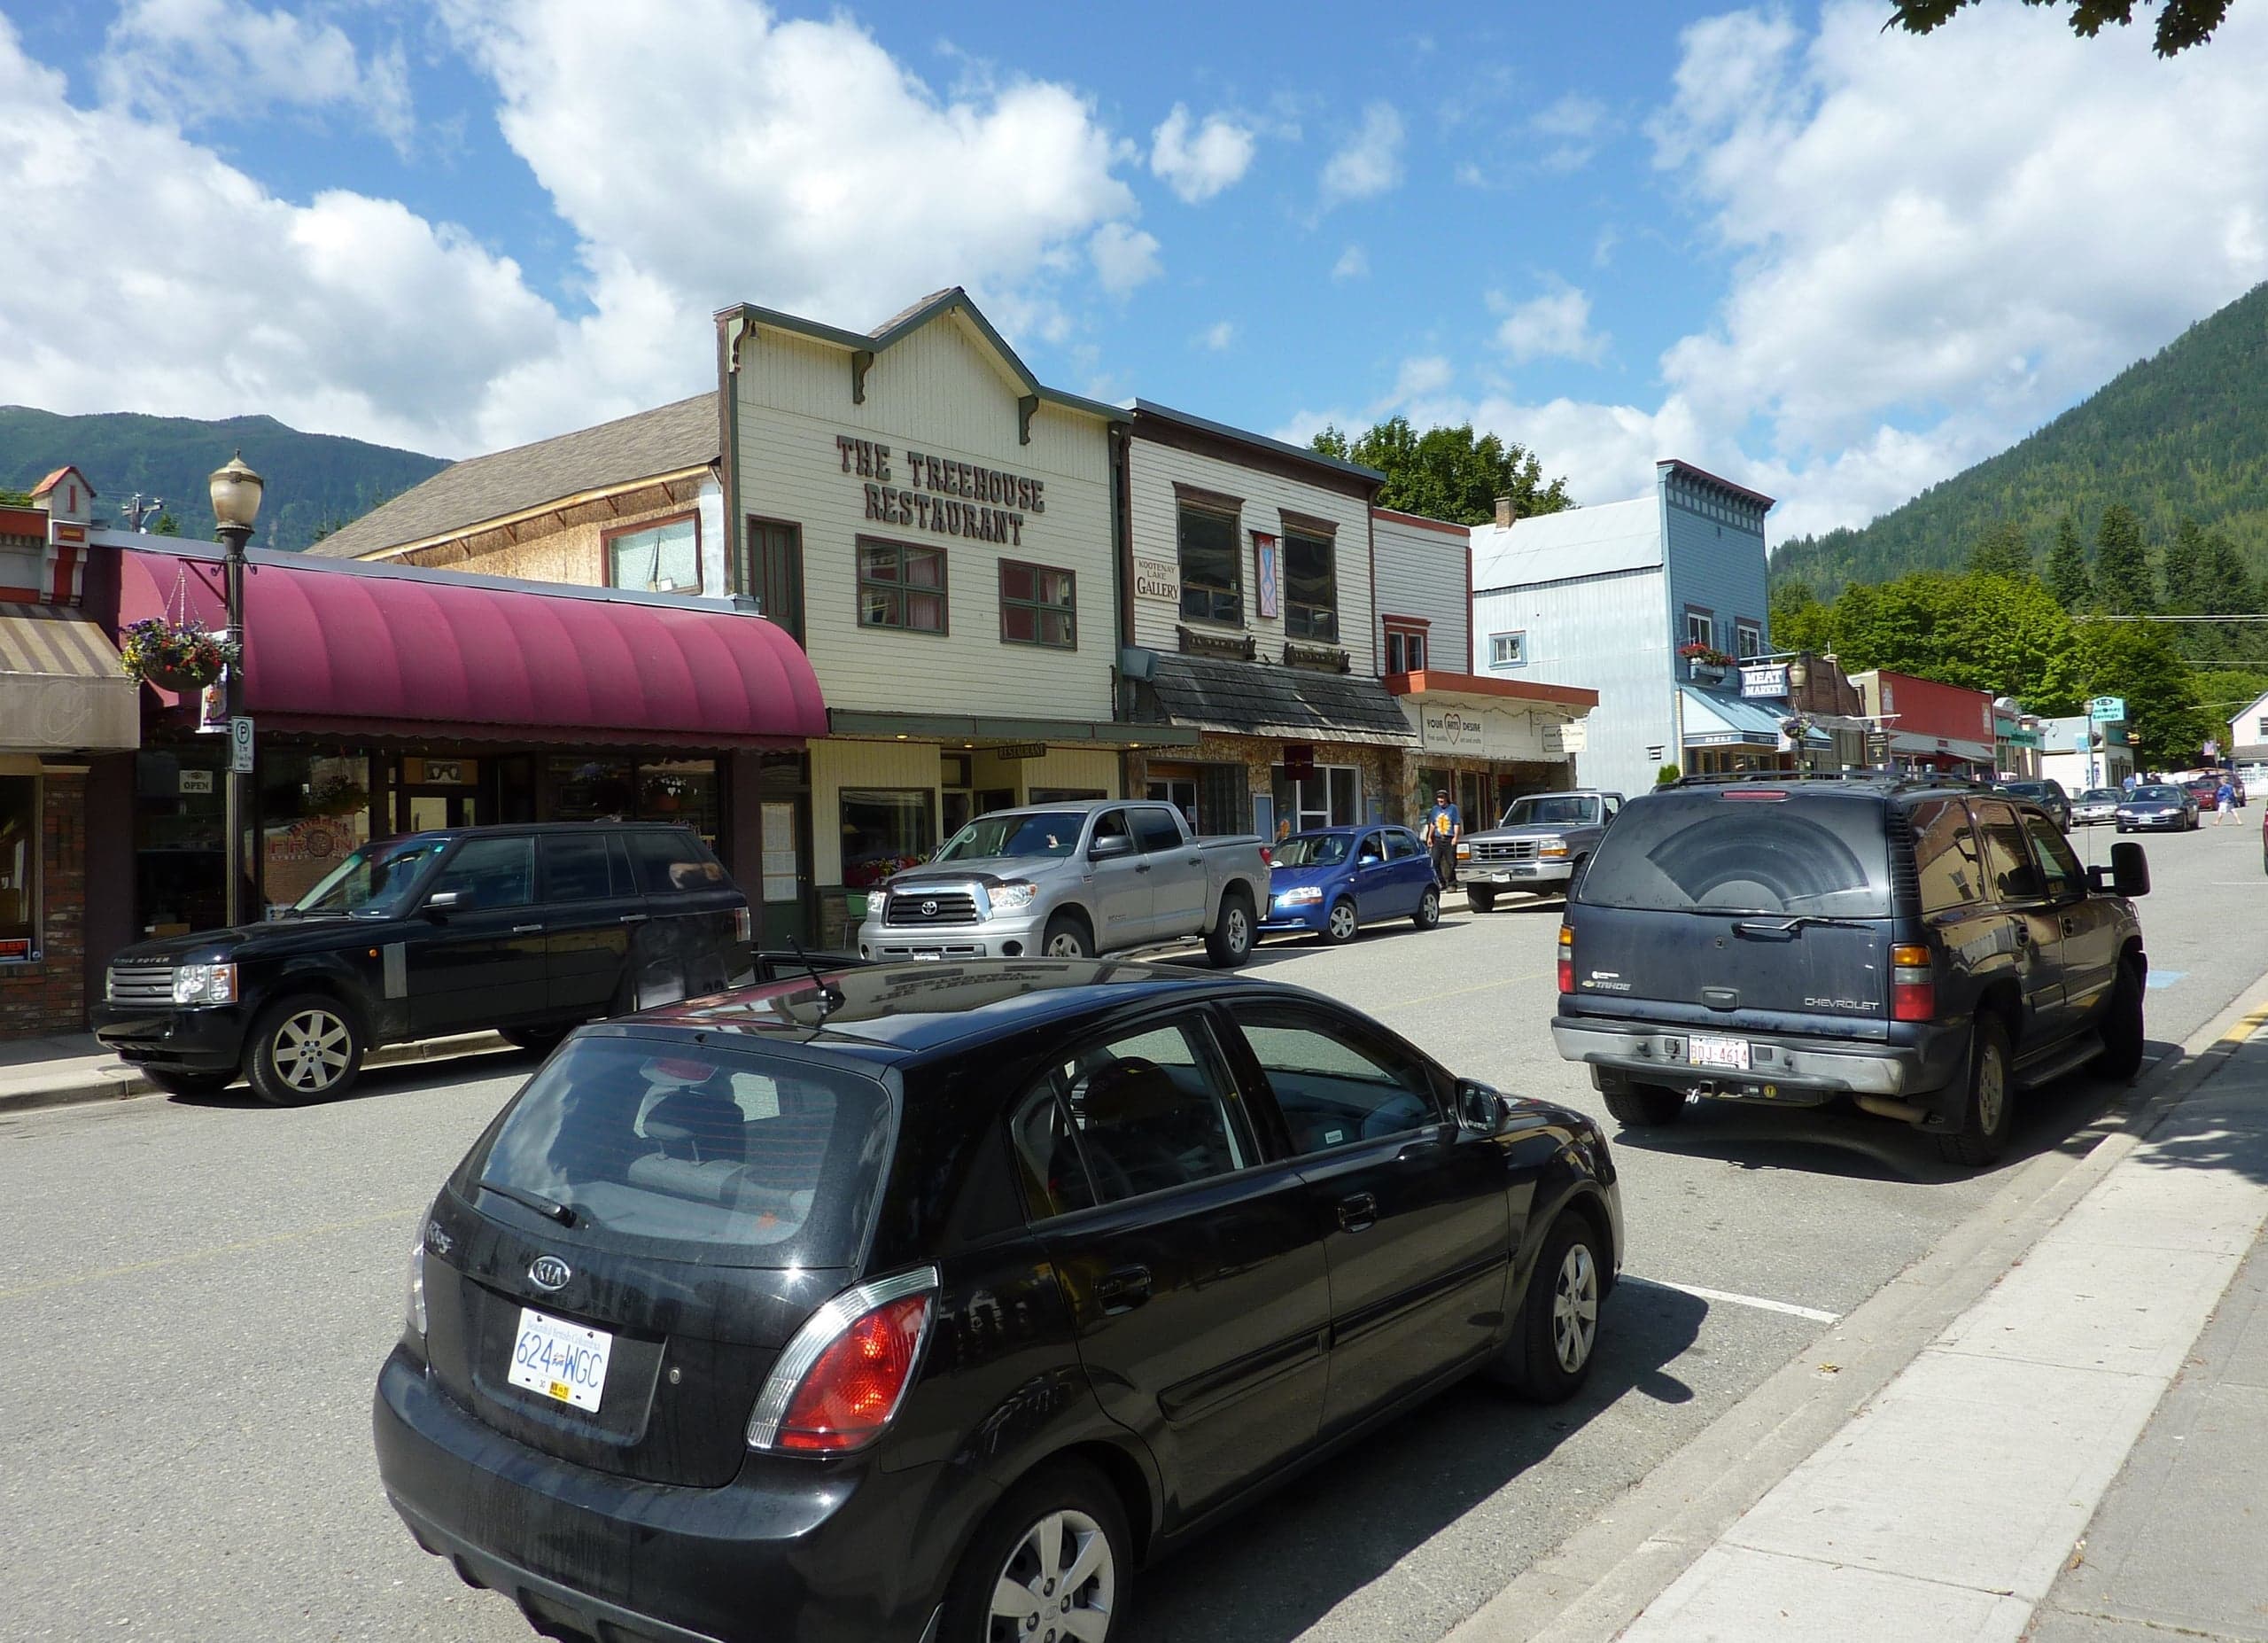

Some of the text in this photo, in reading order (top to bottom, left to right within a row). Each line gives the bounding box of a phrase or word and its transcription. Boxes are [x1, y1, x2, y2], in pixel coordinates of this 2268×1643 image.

[836, 434, 1045, 513] THE TREEHOUSE
[864, 482, 1024, 546] RESTAURANT
[1138, 559, 1177, 574] KOOTENAY
[1146, 569, 1167, 580] LAKE
[1744, 670, 1783, 685] MEAT
[1744, 684, 1783, 696] MARKET
[1426, 719, 1443, 729] YOUR
[1463, 721, 1481, 732] DESIRE
[183, 781, 209, 790] OPEN
[1596, 981, 1632, 991] TAHOE
[1805, 997, 1880, 1010] CHEVROLET
[535, 1261, 563, 1285] KIA
[517, 1331, 602, 1388] 624 WGC
